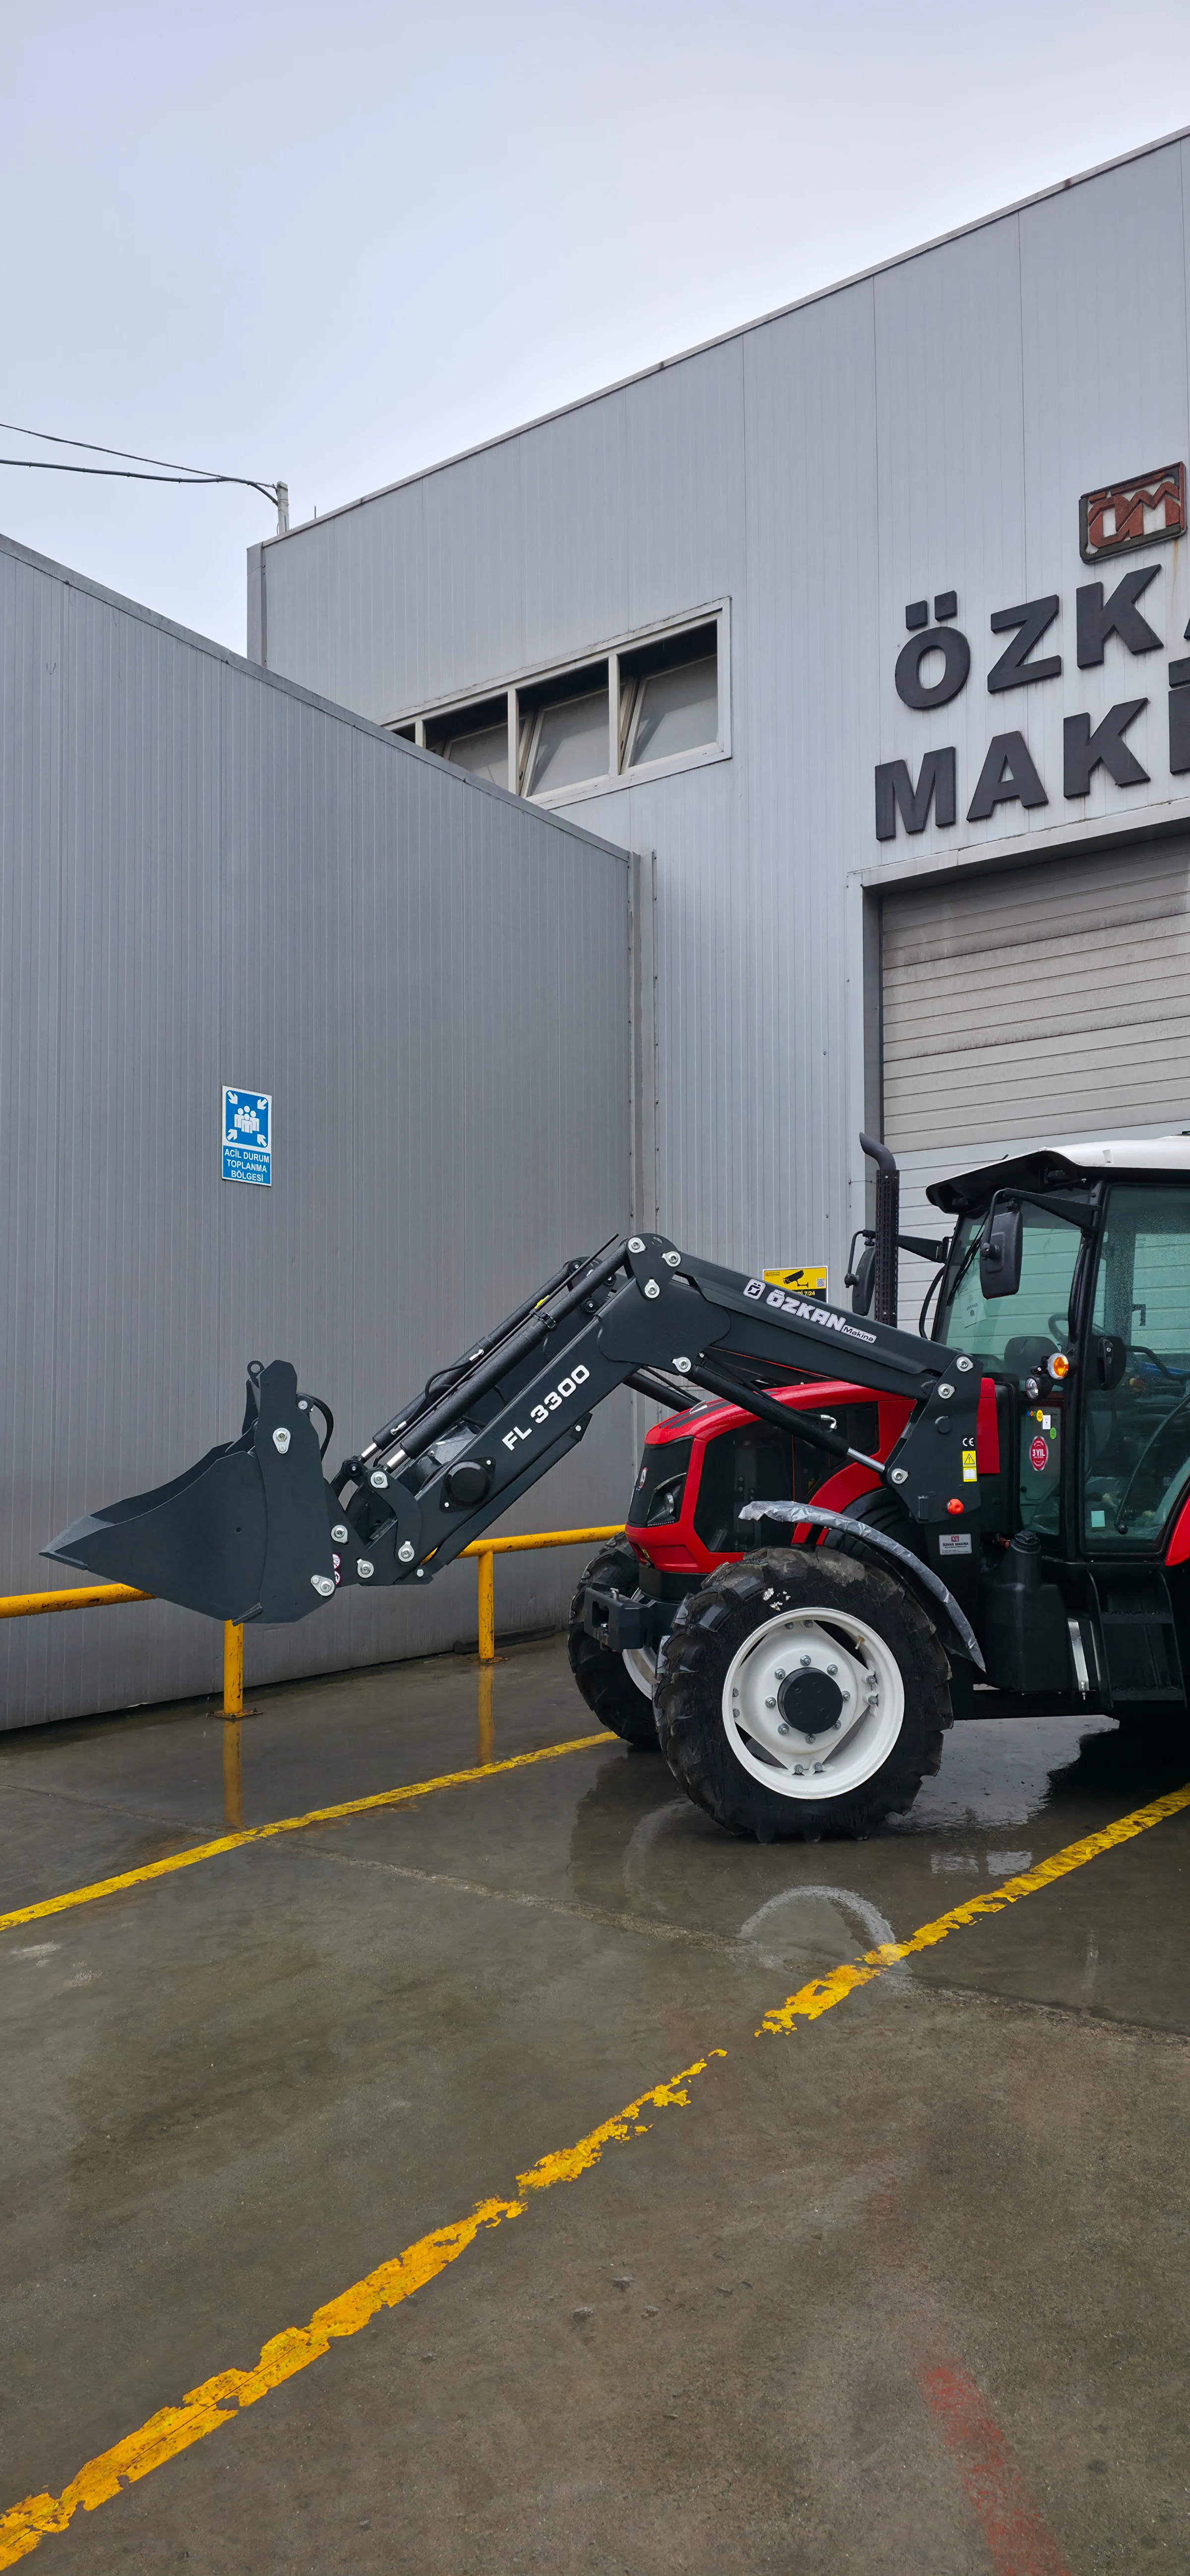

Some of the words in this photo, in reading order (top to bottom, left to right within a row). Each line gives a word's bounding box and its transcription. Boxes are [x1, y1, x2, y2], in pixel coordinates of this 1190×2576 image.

[895, 564, 1190, 709] ÖZK
[225, 1148, 241, 1158] ACİL
[243, 1152, 269, 1163] DURUM
[227, 1159, 267, 1172] TOPLANMA
[231, 1170, 263, 1182] BÖLGESİ
[766, 1289, 845, 1331] ÖZKAN
[843, 1327, 874, 1341] Makina
[502, 1426, 532, 1451] FL
[531, 1365, 590, 1423] 3300
[963, 1438, 974, 1446] CE
